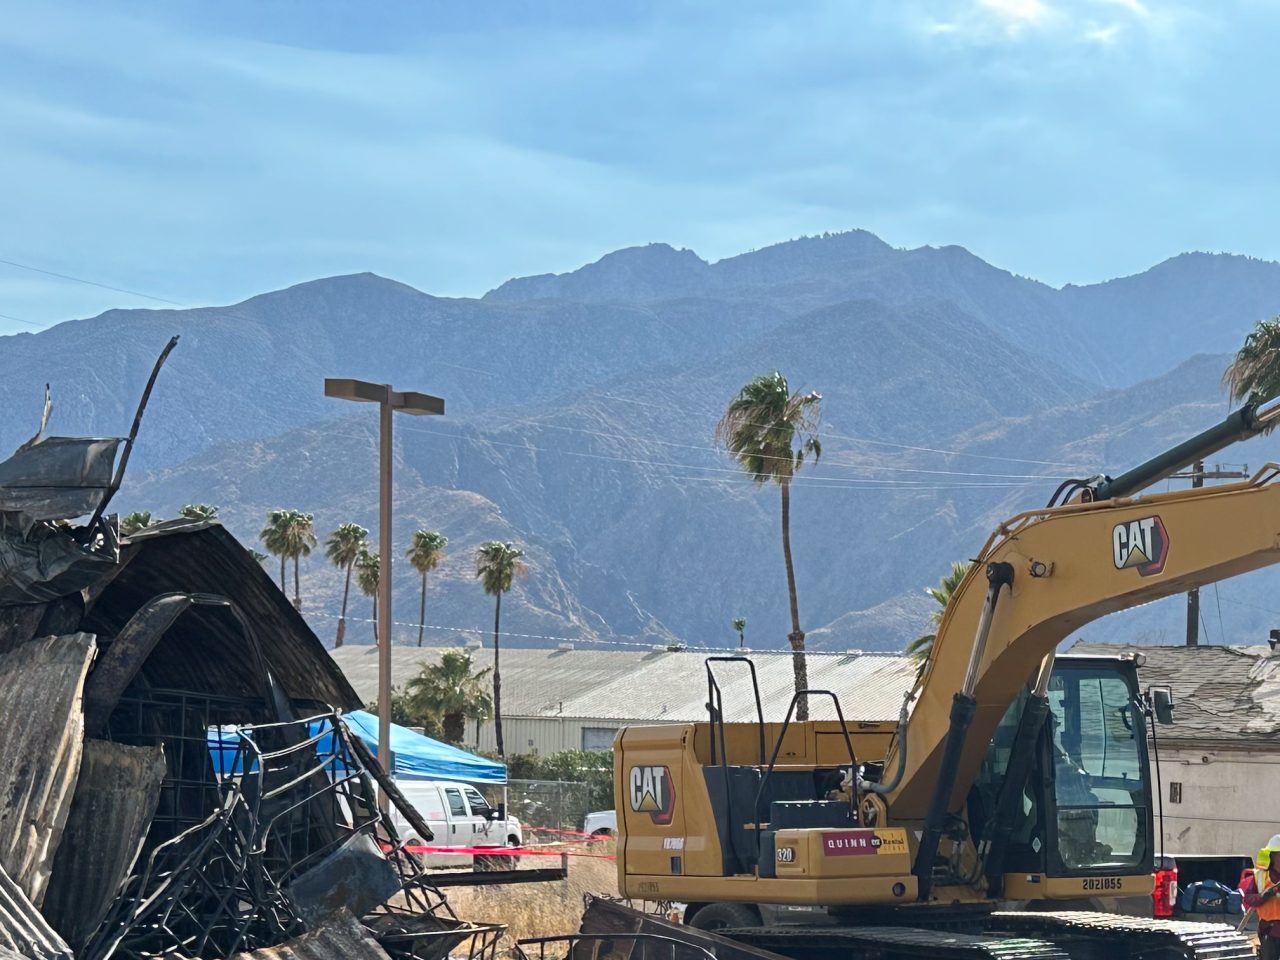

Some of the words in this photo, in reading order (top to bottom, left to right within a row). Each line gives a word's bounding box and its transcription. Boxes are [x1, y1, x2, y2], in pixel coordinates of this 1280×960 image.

[1113, 517, 1155, 569] CAT
[630, 766, 665, 811] CAT
[777, 847, 792, 862] 320
[828, 838, 867, 849] QUINN
